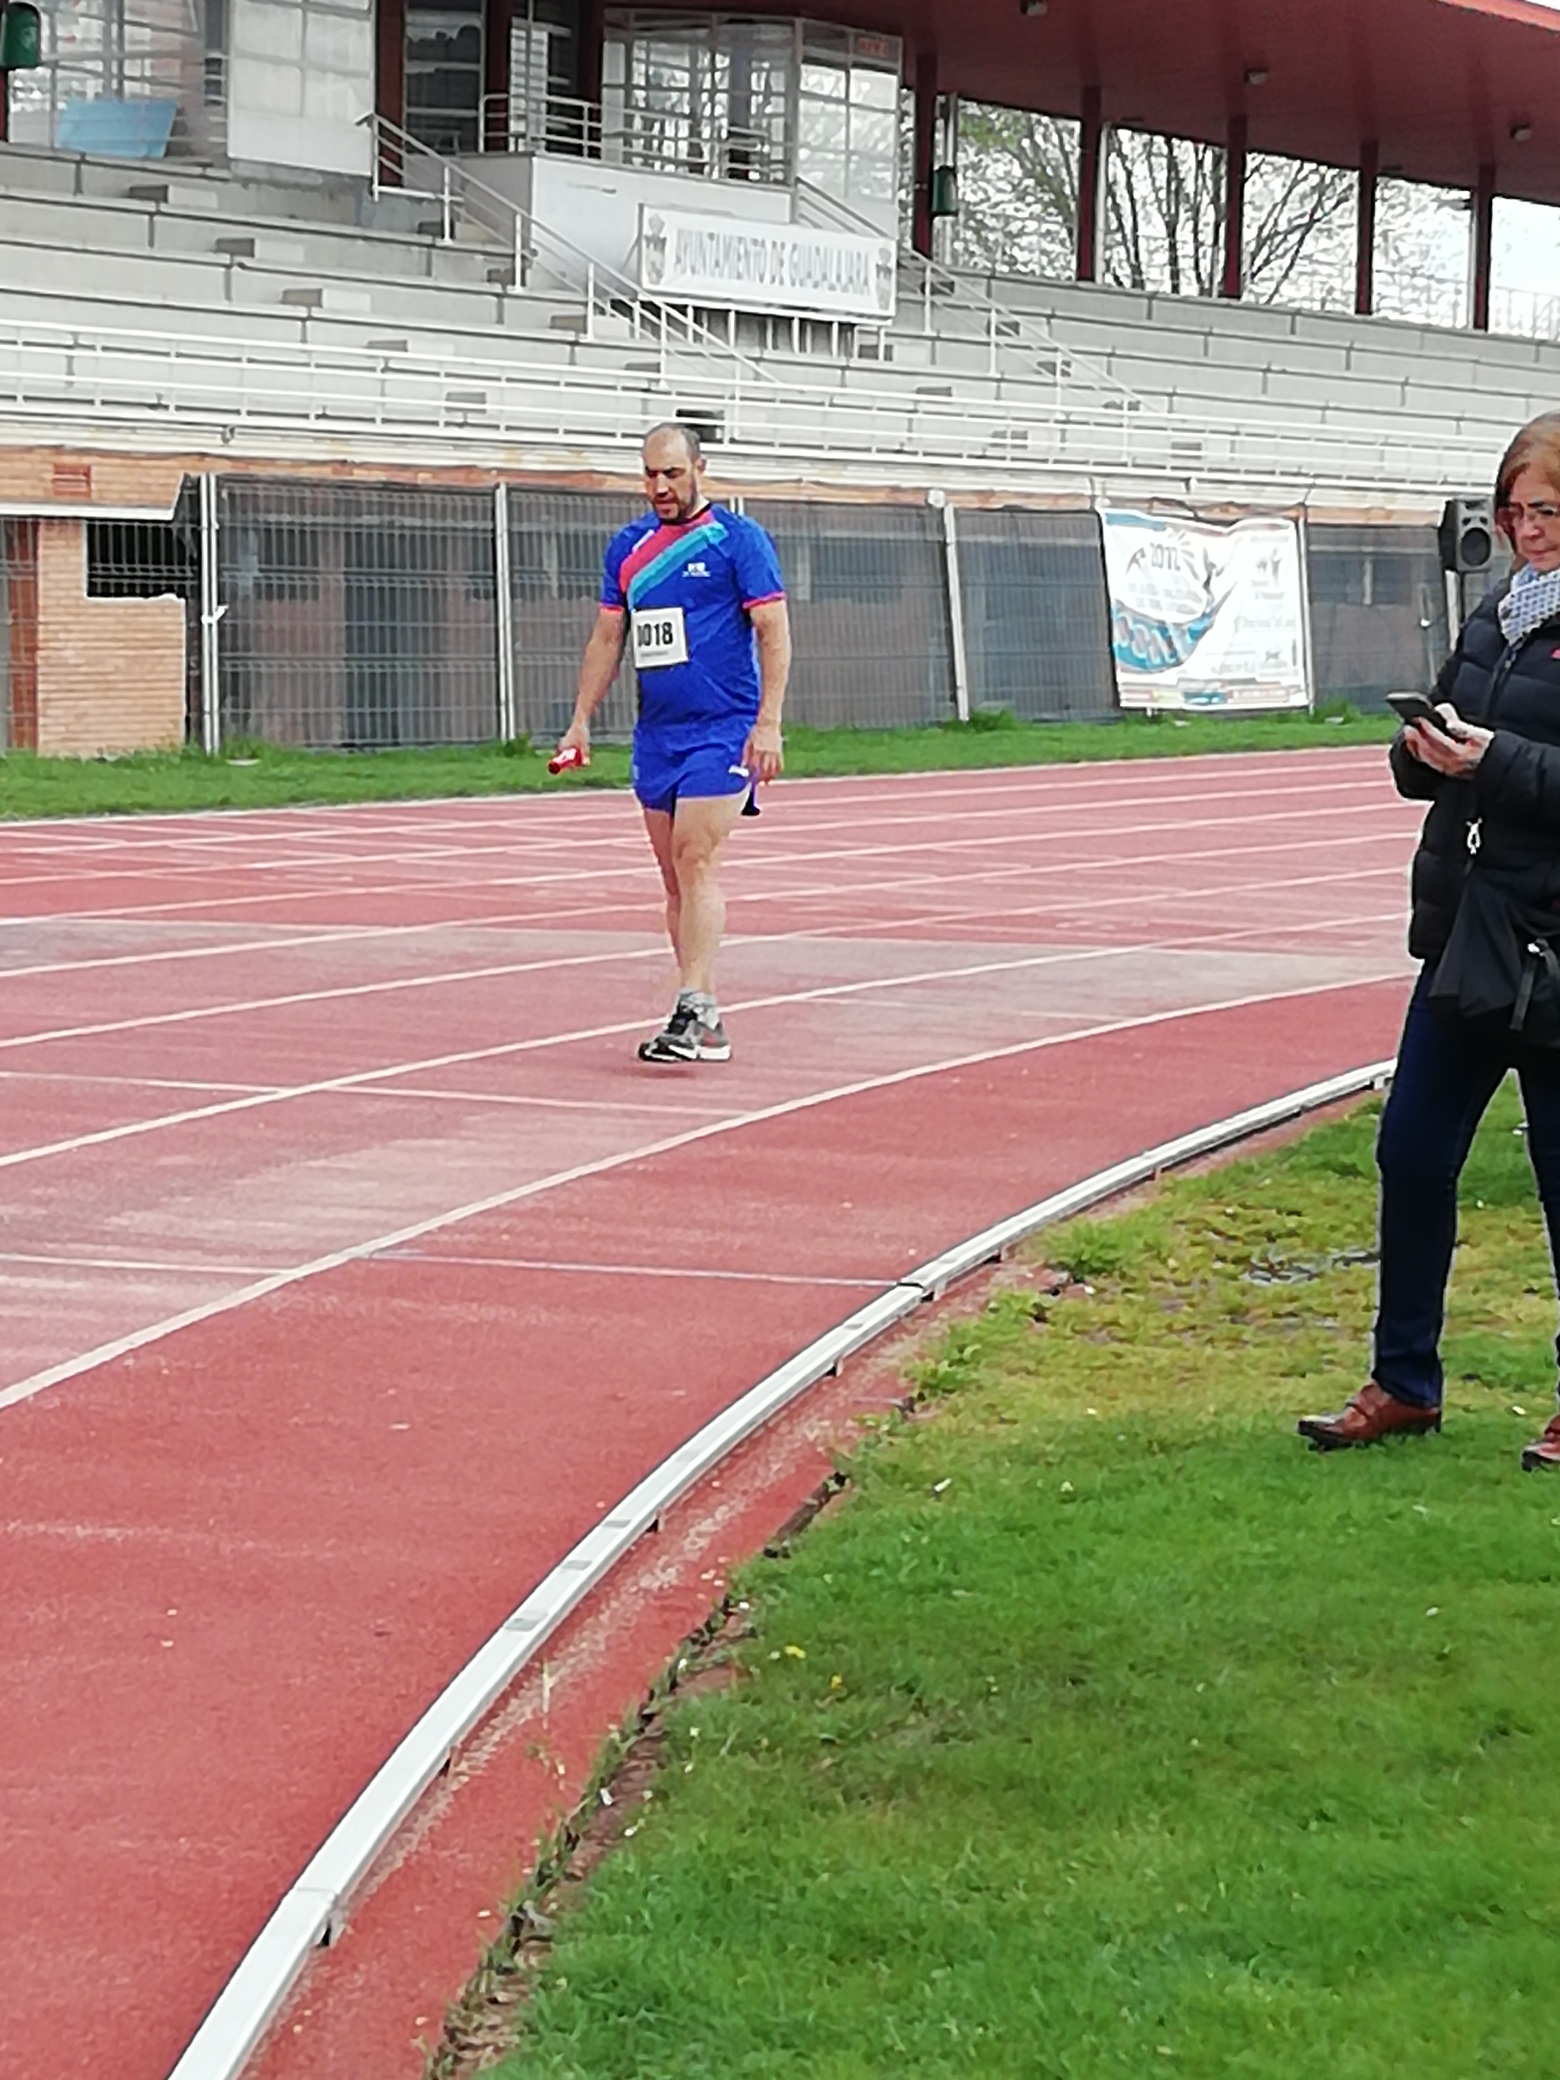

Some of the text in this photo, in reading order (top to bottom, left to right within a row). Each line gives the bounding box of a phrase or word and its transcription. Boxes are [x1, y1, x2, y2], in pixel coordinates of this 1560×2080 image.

[674, 228, 871, 296] AYUNTAMIENTO DE GUADALAJARA
